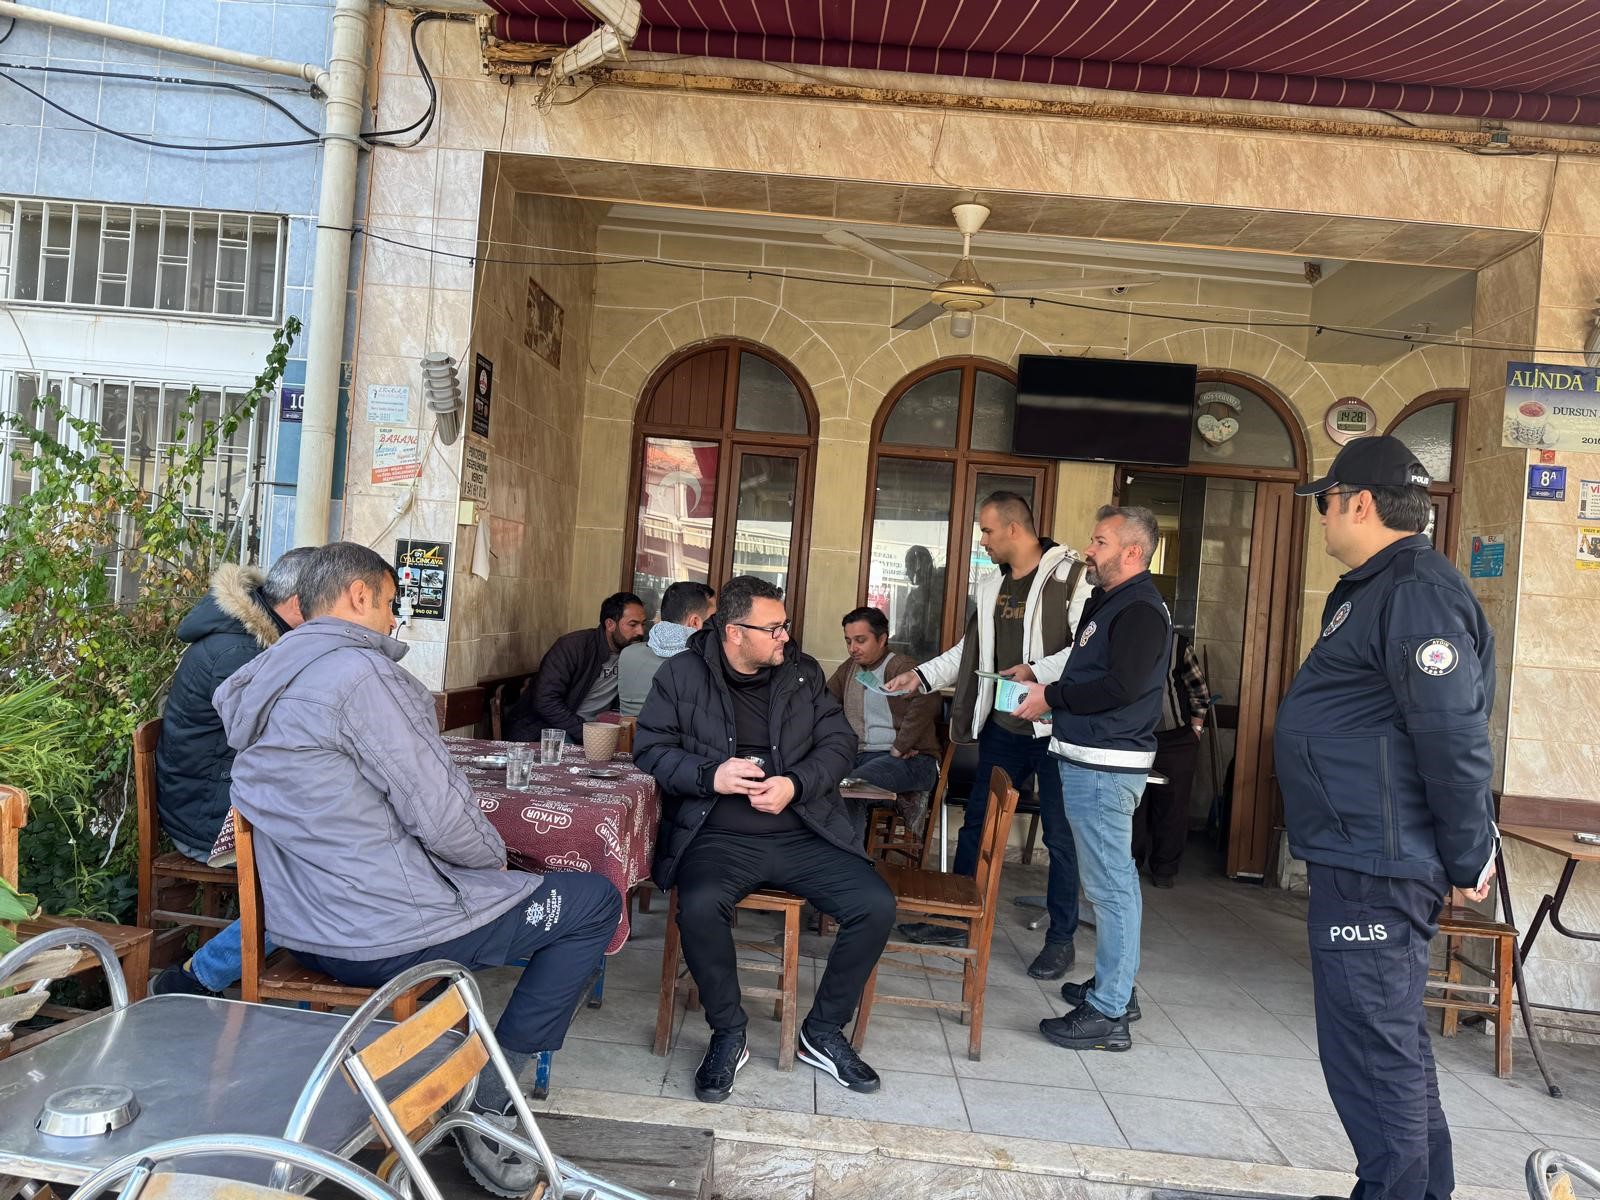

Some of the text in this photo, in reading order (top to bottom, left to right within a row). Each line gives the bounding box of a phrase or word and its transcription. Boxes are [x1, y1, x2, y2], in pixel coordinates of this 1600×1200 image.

[1552, 406, 1597, 418] DURSUN
[526, 808, 568, 826] ÇAYKUR
[549, 857, 589, 870] ÇAYKUR
